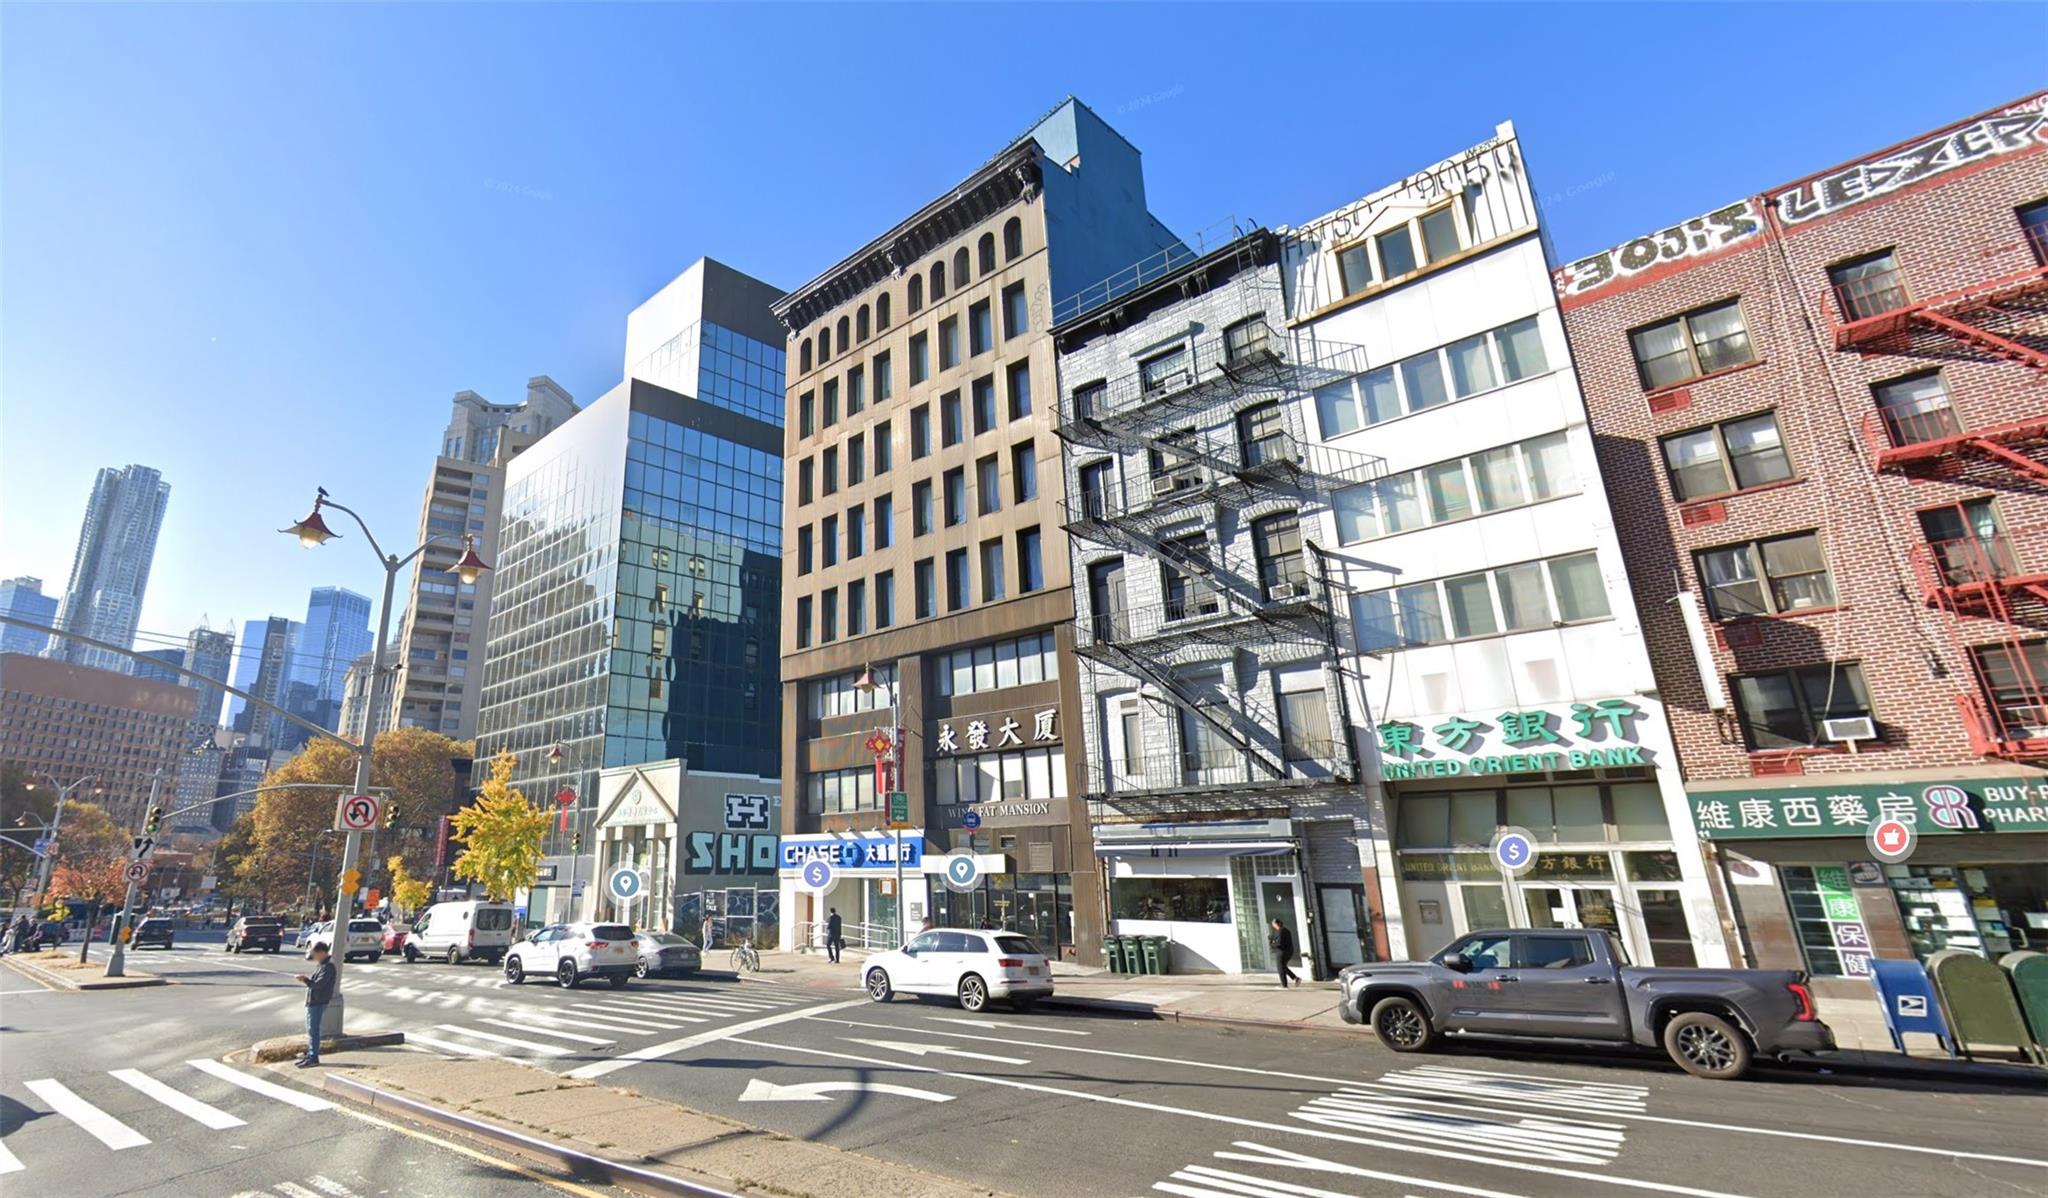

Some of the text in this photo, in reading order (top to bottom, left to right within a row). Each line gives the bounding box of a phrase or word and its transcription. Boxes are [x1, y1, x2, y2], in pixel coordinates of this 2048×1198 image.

[1376, 699, 1635, 757] 東方銀行
[1381, 745, 1646, 783] UNITED ORIENT BANK
[978, 806, 996, 818] FAT
[1000, 802, 1050, 817] MANSION
[1696, 792, 1918, 829] 維康西藥房
[784, 843, 842, 865] CHASE
[1818, 868, 1869, 973] 維康保健
